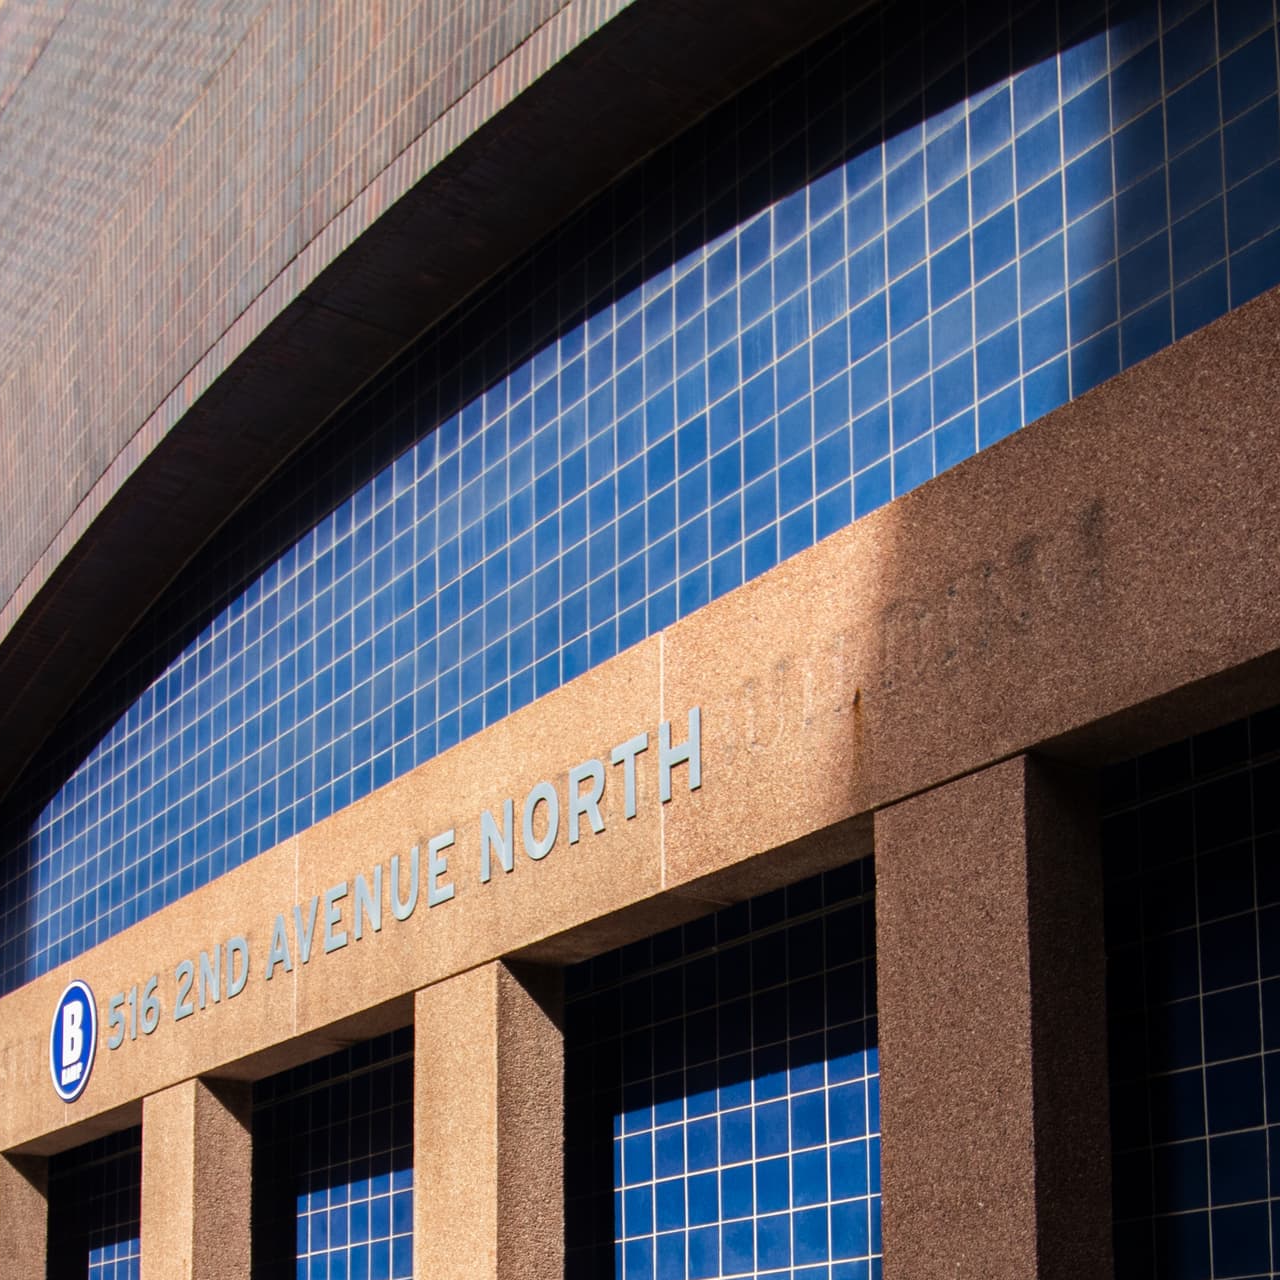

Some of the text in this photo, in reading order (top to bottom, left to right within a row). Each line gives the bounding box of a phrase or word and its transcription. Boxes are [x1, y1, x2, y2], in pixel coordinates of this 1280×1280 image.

[107, 705, 701, 1050] 516 2ND AVENUE NORTH
[62, 1000, 84, 1067] B
